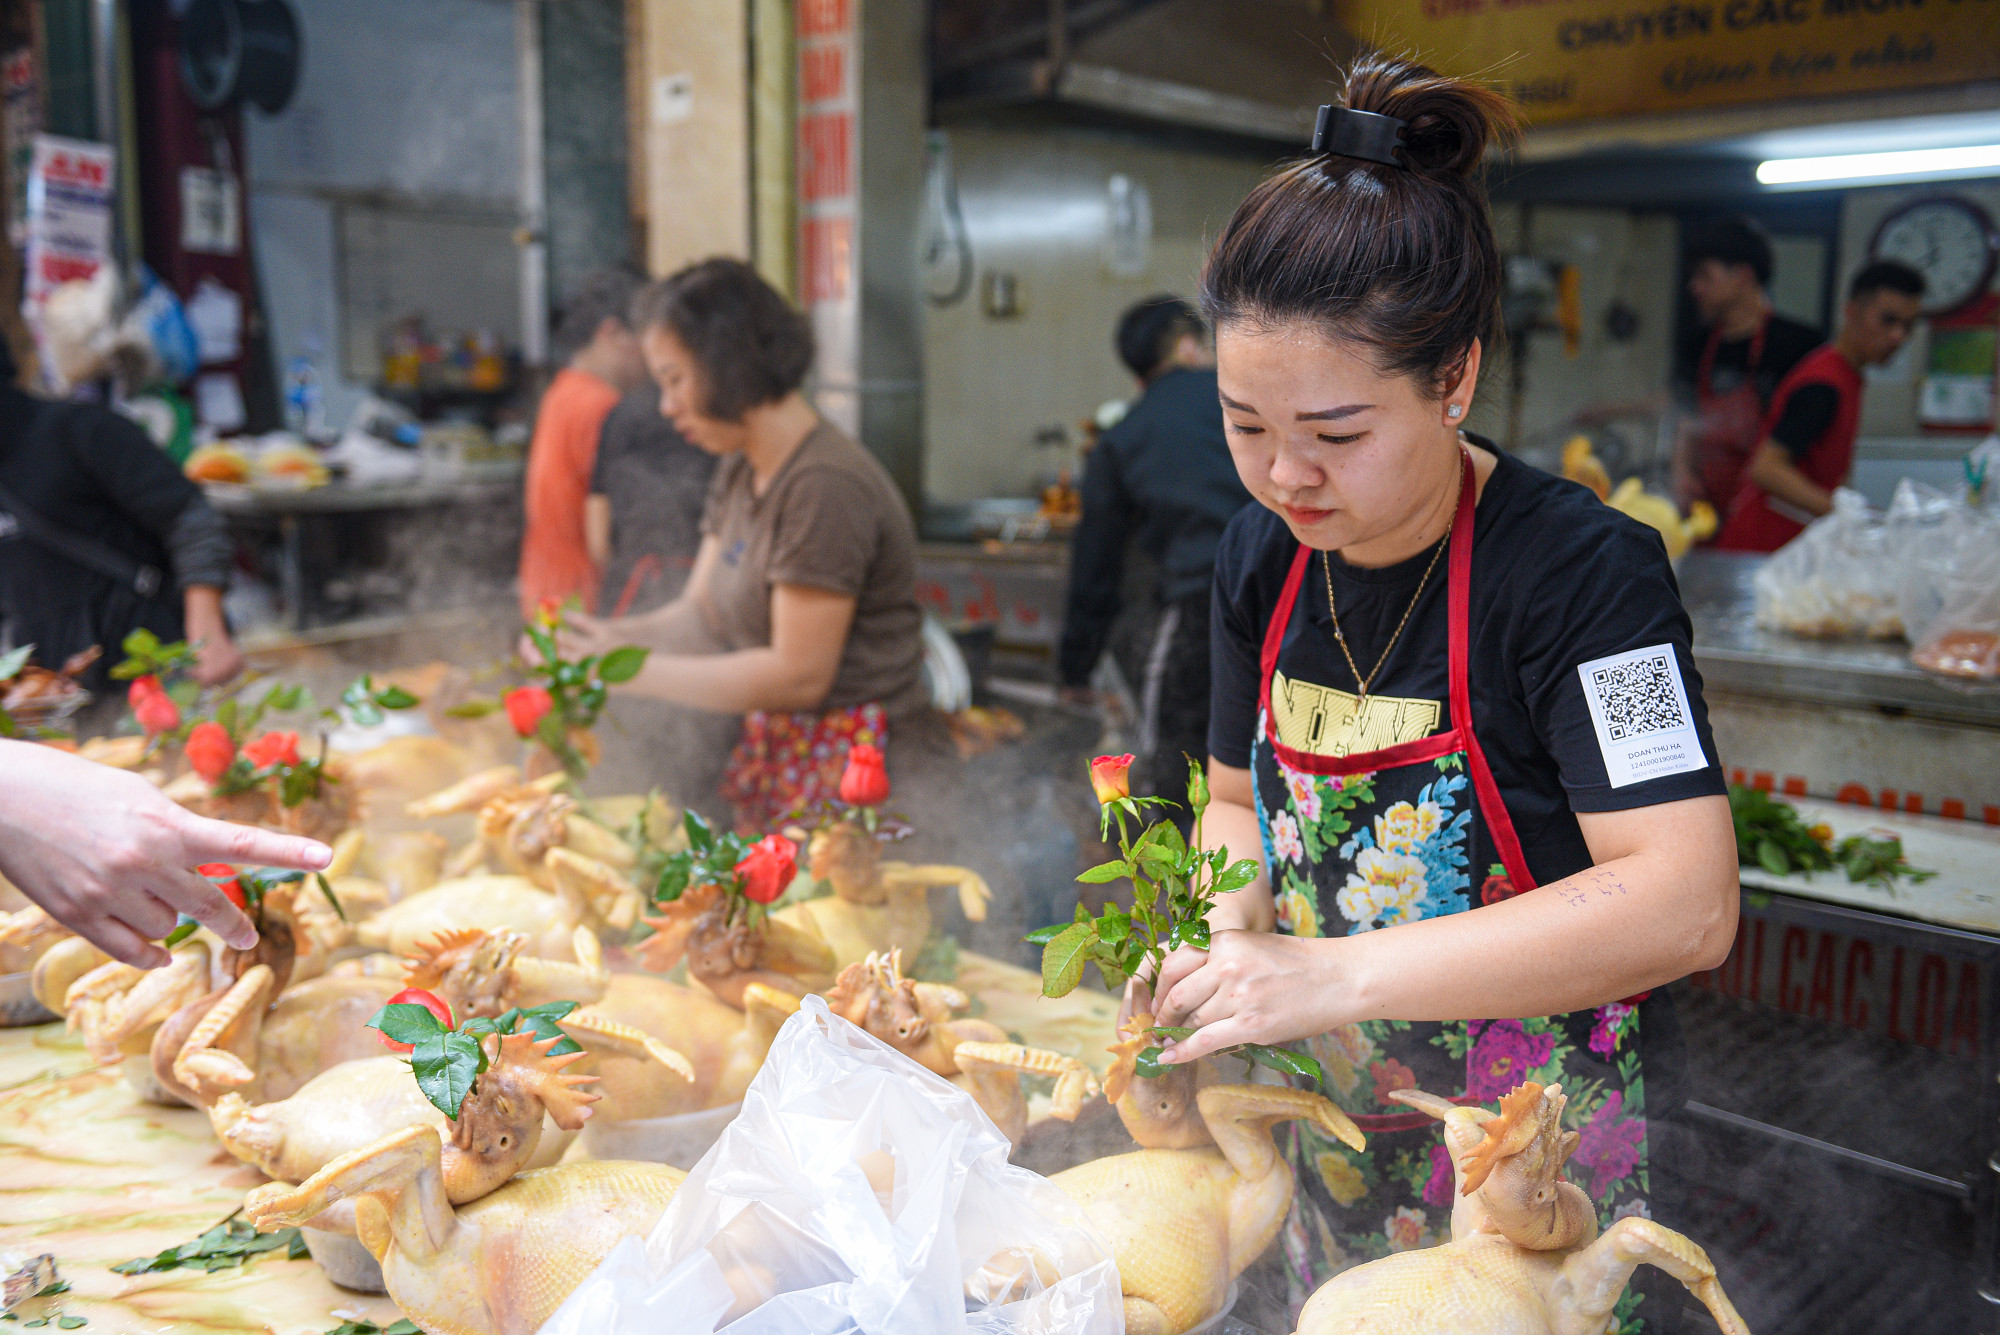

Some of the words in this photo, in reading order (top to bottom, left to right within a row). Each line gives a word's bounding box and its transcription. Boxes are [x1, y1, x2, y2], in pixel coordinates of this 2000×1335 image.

[1628, 748, 1652, 760] DOAN
[1653, 744, 1669, 754] THU
[1670, 742, 1682, 751] HA
